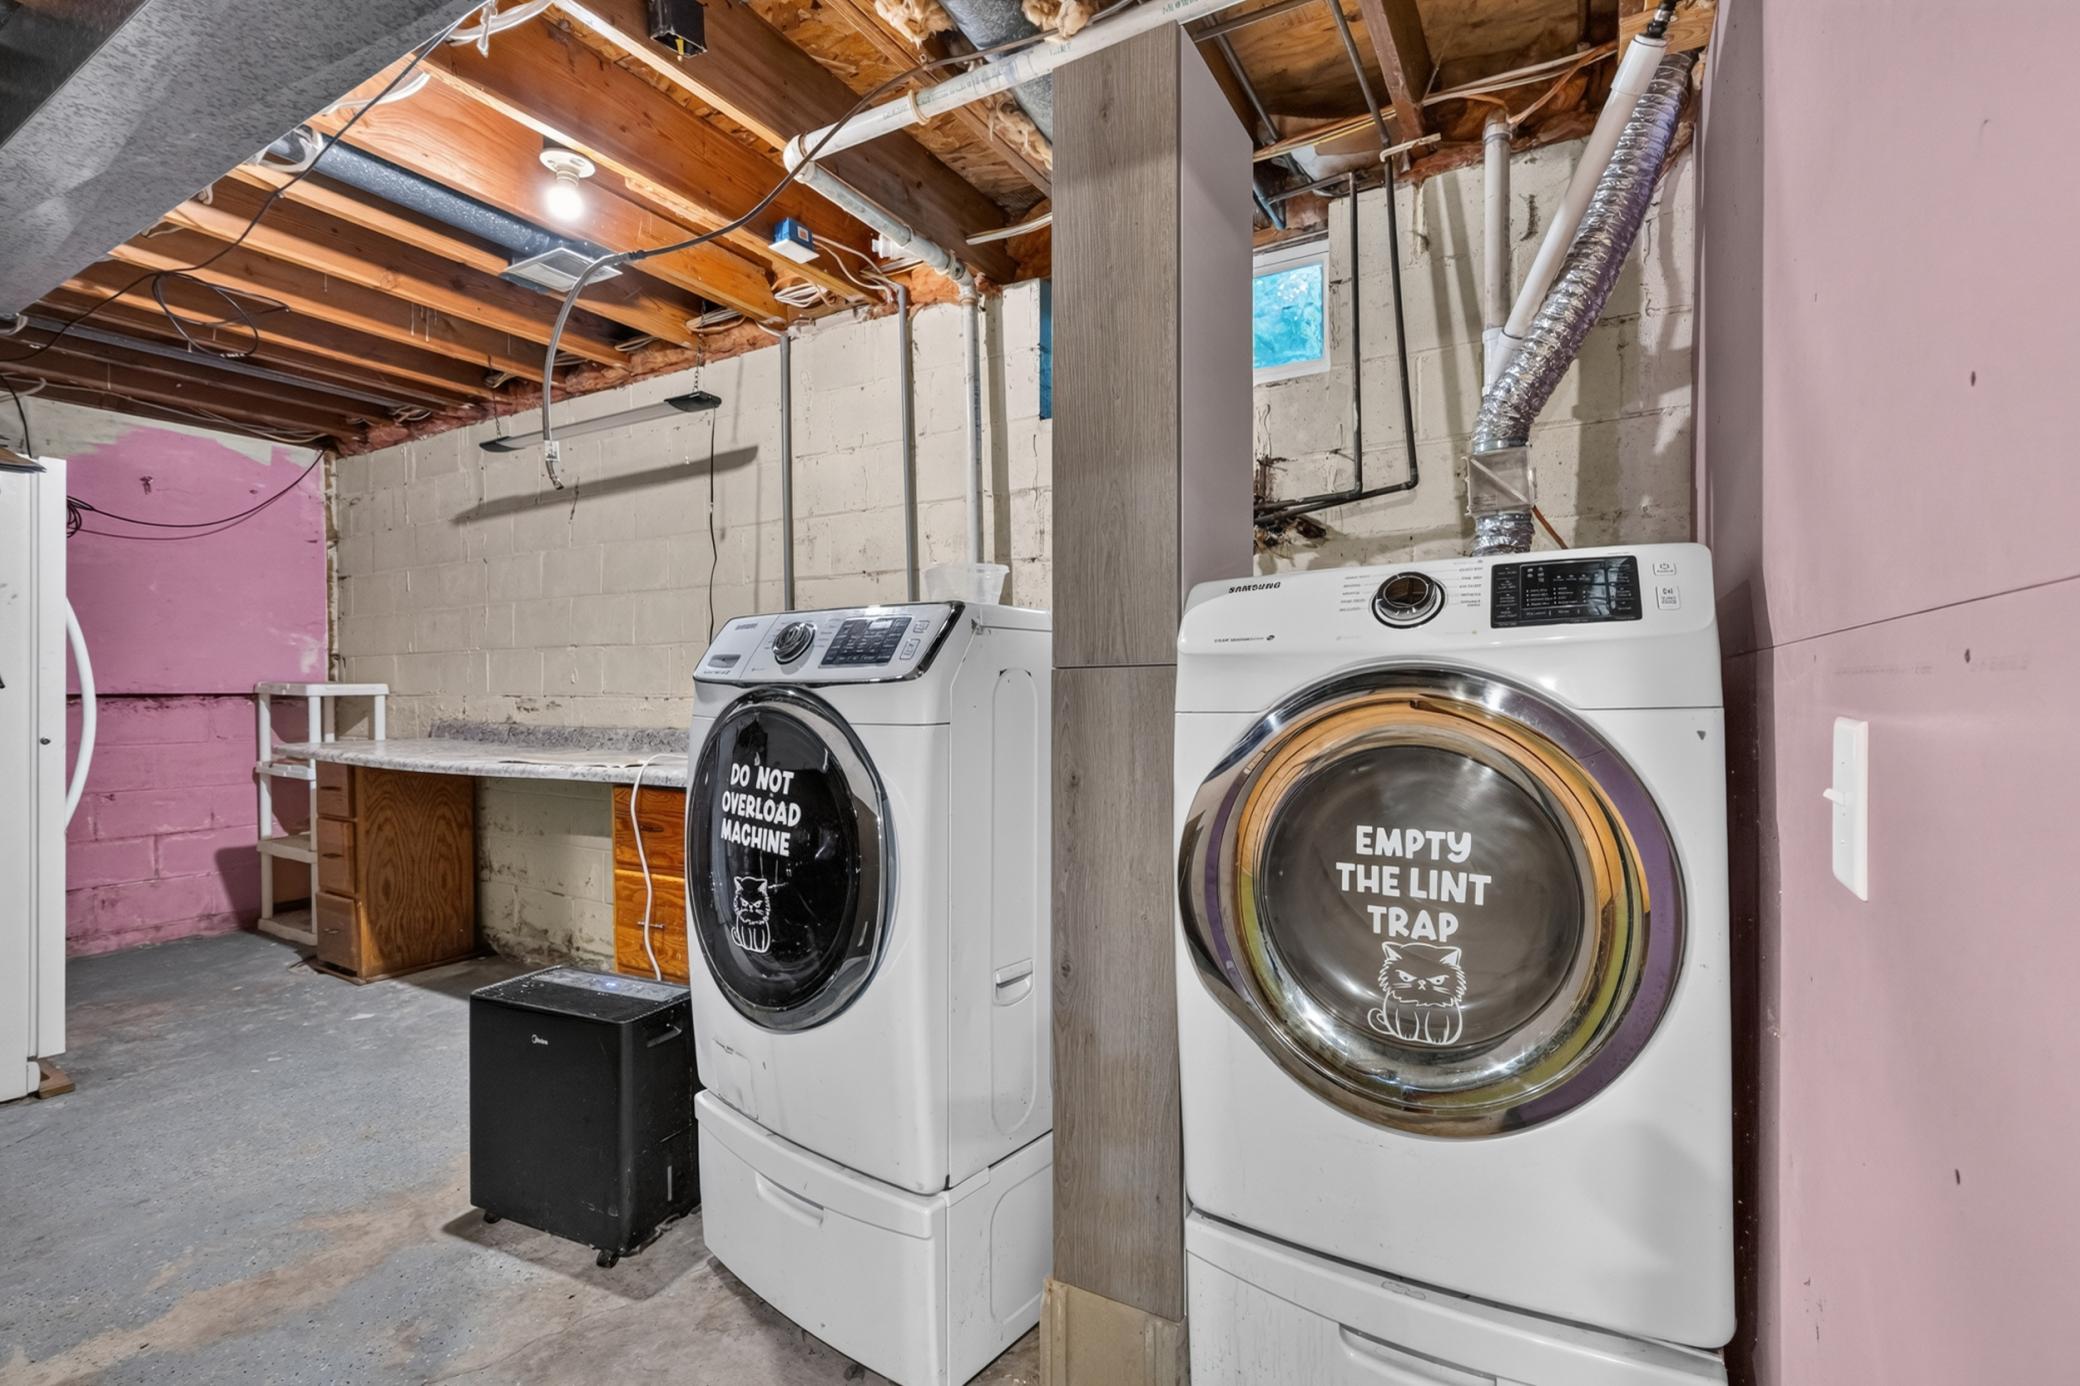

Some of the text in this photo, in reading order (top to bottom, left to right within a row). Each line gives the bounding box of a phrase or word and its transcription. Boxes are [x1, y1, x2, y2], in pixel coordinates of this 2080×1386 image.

[1228, 581, 1281, 594] SAMSUNG
[730, 762, 795, 795] DO NOT
[721, 790, 802, 827] OVERLOAD
[720, 818, 791, 857] MACHINE
[1355, 824, 1472, 863] EMPTY
[1335, 861, 1492, 906] THE LINT
[1366, 904, 1459, 943] TRAP
